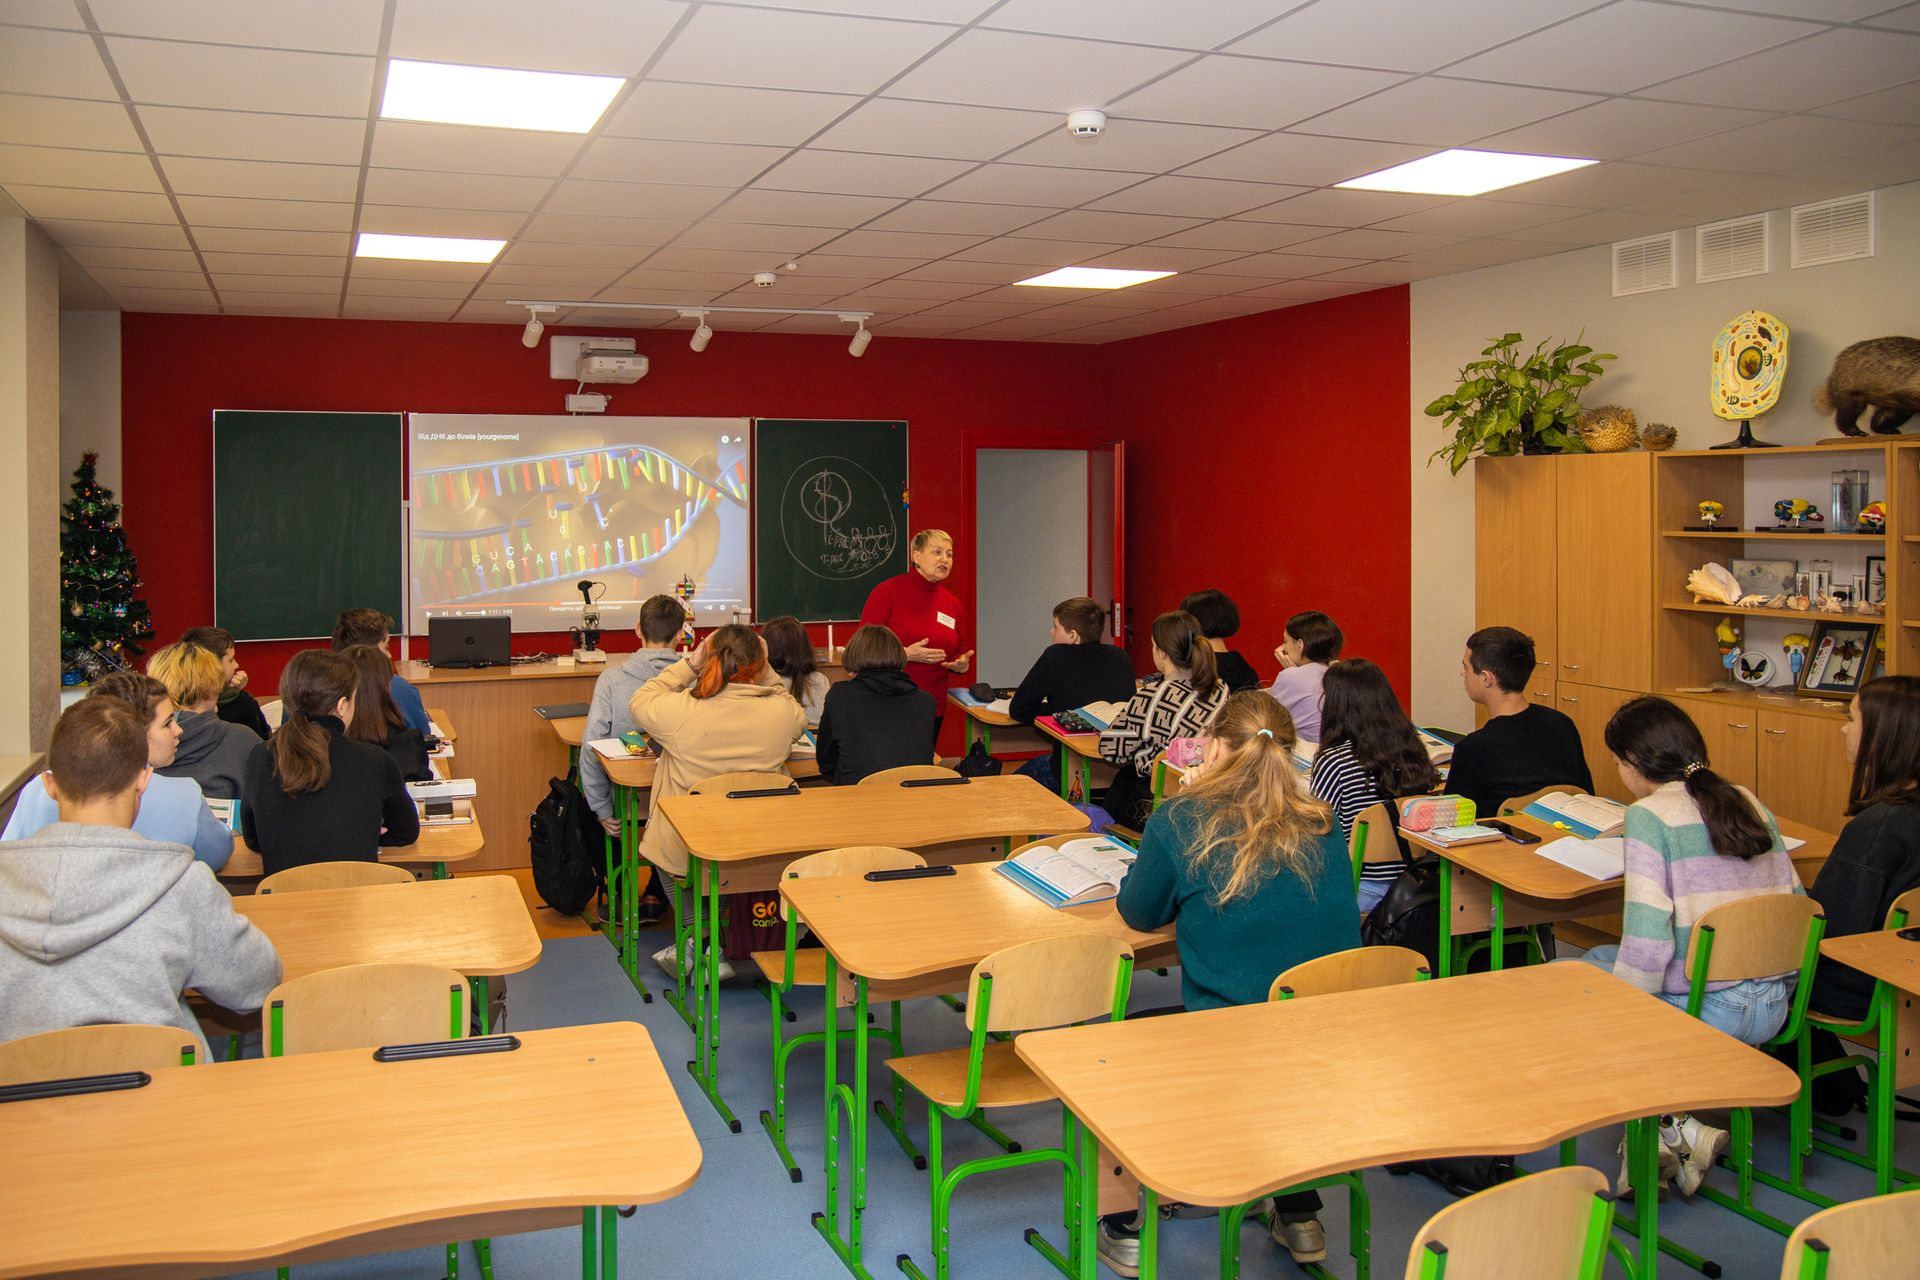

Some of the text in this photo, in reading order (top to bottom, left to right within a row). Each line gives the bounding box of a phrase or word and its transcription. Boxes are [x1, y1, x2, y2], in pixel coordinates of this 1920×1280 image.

[579, 482, 588, 492] U
[549, 509, 557, 519] U
[600, 517, 609, 527] C
